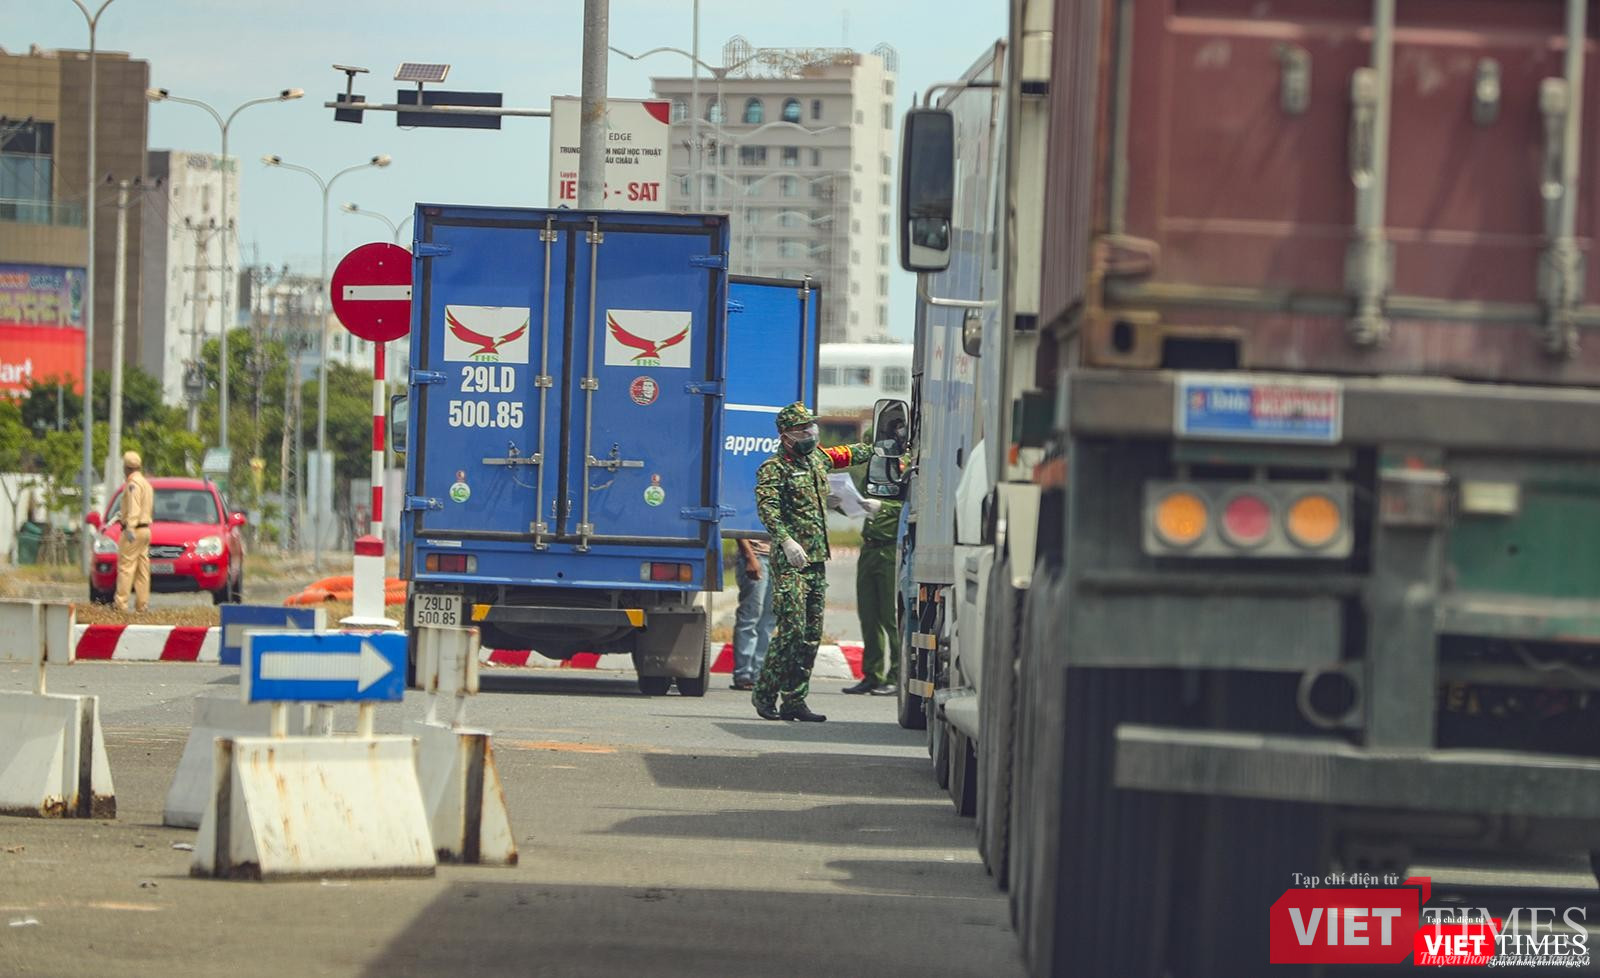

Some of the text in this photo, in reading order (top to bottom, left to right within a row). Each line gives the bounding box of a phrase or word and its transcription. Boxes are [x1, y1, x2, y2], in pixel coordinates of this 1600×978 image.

[608, 132, 632, 141] EDGE
[627, 182, 660, 201] SAT
[473, 354, 500, 362] THS
[636, 358, 661, 366] THS
[0, 357, 32, 384] art
[460, 365, 516, 393] 29LD
[448, 400, 524, 429] 500.85
[724, 435, 781, 456] approa
[424, 596, 452, 611] 29LD
[417, 610, 456, 625] 500.85
